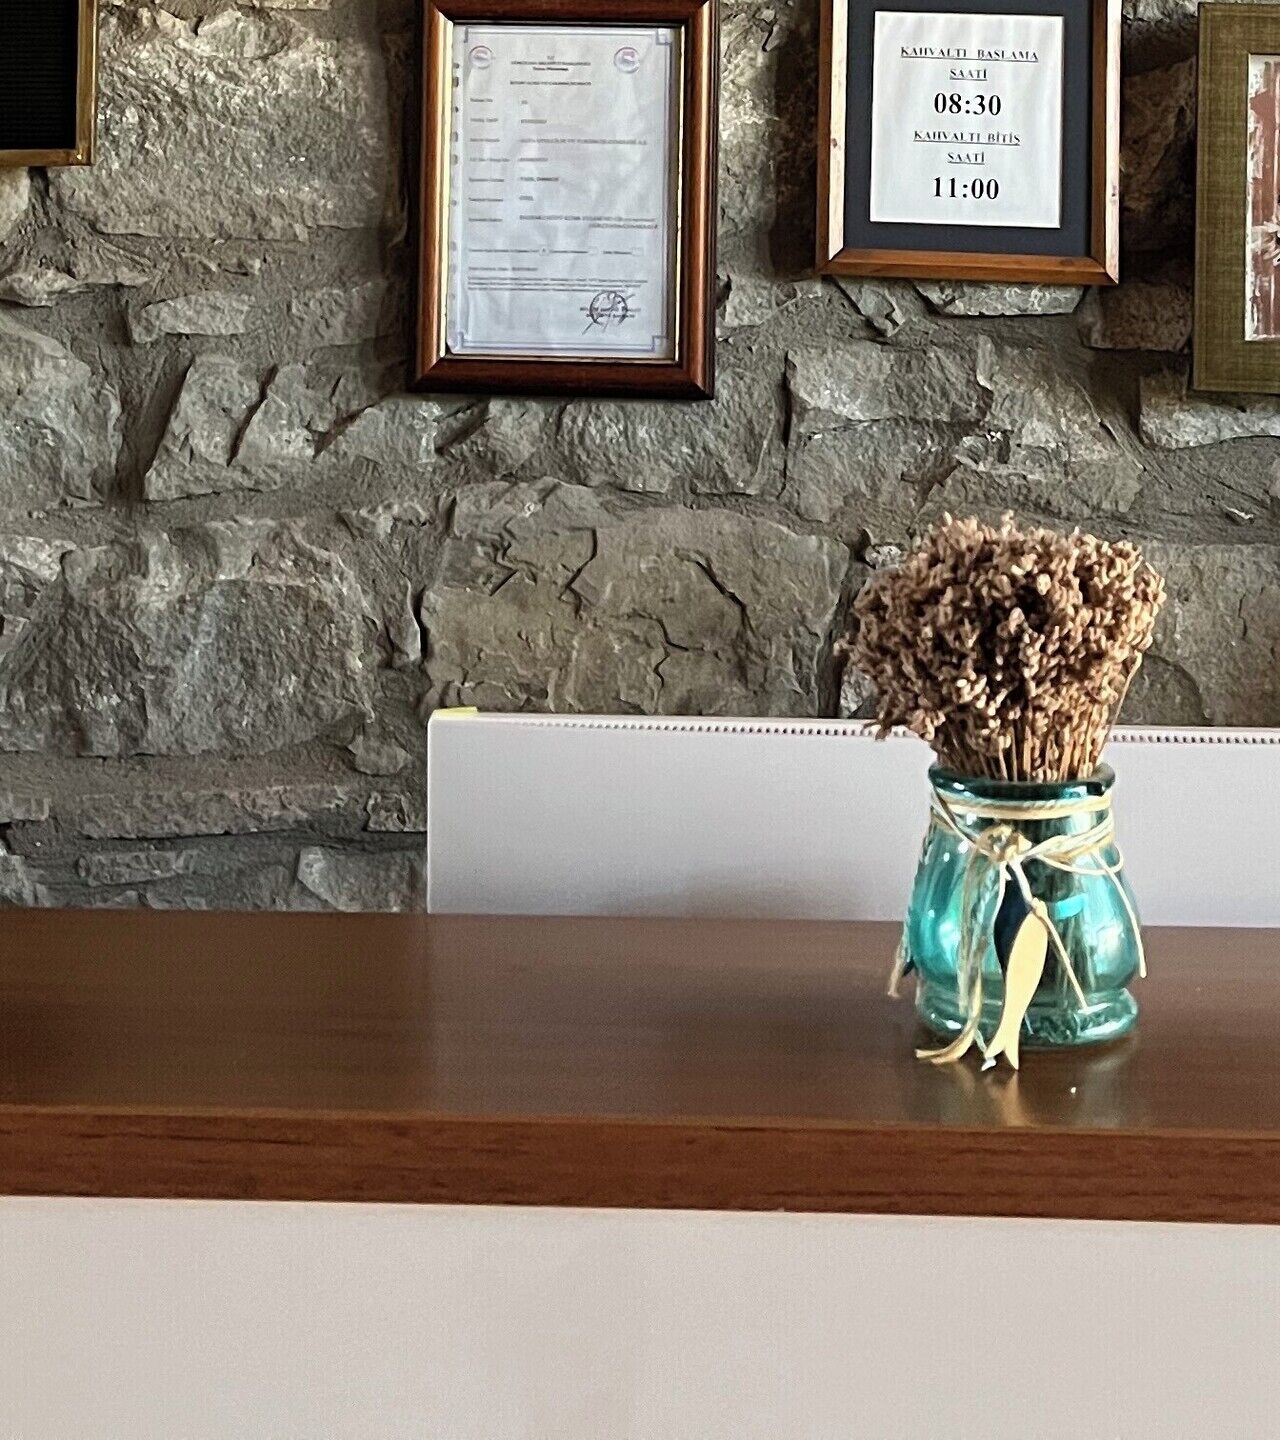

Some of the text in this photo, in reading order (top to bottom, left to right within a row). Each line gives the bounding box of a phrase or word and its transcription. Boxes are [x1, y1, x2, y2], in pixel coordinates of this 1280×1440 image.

[901, 46, 968, 60] KAHVALTI
[949, 67, 988, 80] SAATİ
[934, 92, 1002, 116] 08:30
[913, 130, 982, 144] KAHVALTI
[947, 151, 985, 165] SAATİ
[934, 176, 1000, 200] 11:00
